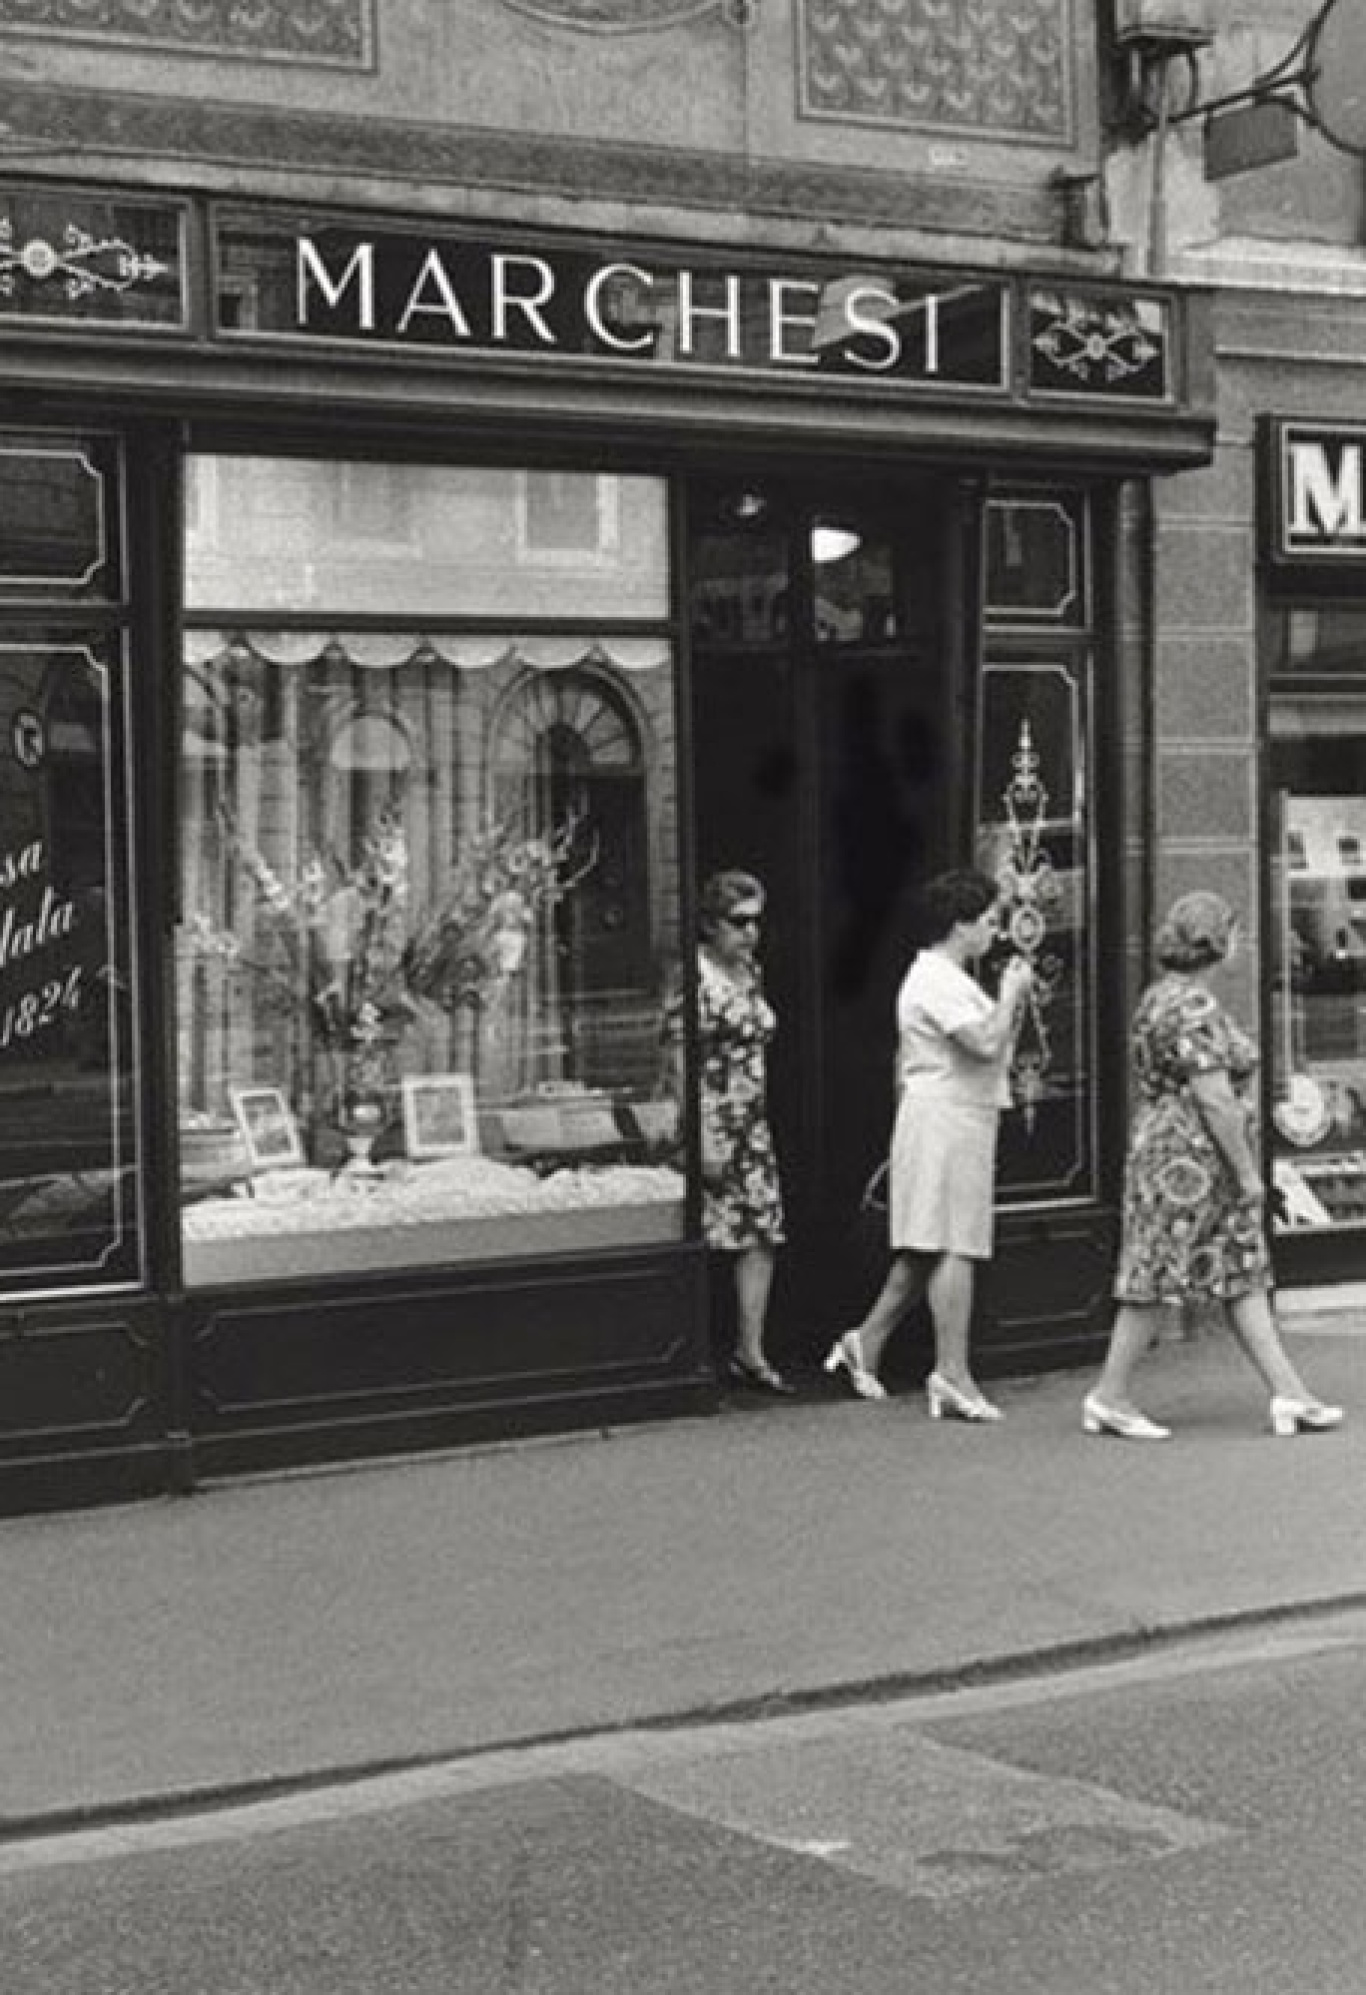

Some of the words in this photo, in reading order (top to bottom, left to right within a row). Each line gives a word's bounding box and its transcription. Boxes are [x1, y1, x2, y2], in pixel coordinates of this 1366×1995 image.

[297, 237, 939, 373] MARCHESI
[1288, 442, 1366, 534] M
[0, 965, 82, 1046] 1824
